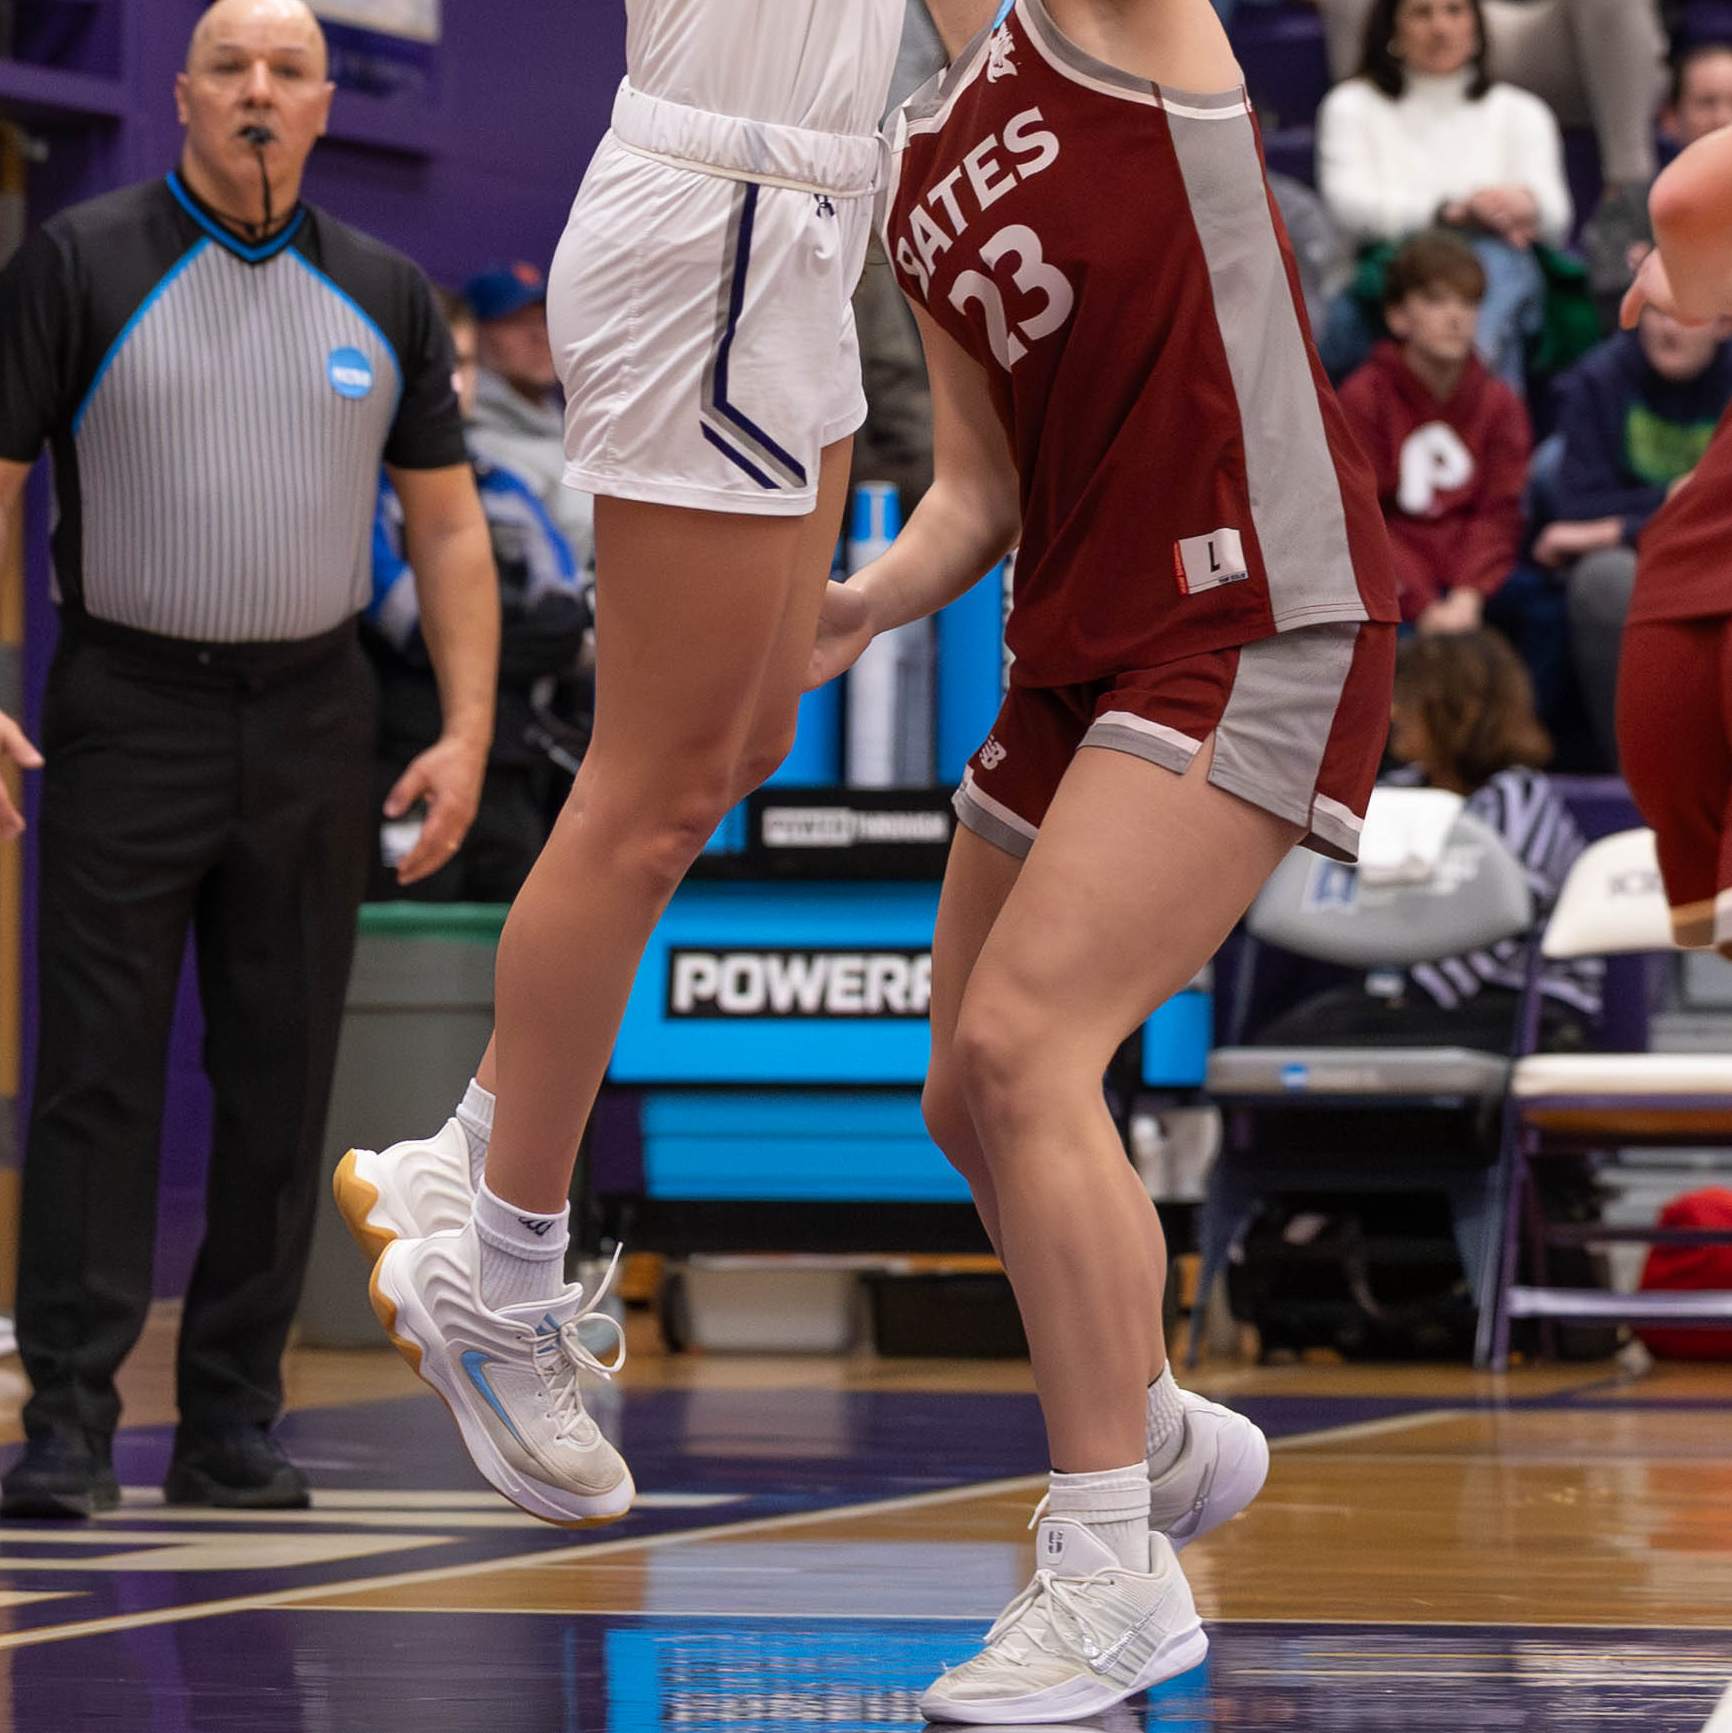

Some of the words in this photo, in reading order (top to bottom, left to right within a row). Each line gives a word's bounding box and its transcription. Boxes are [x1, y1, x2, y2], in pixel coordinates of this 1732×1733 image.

[896, 106, 1060, 302] BATES
[947, 224, 1075, 374] 23
[1208, 541, 1221, 574] L
